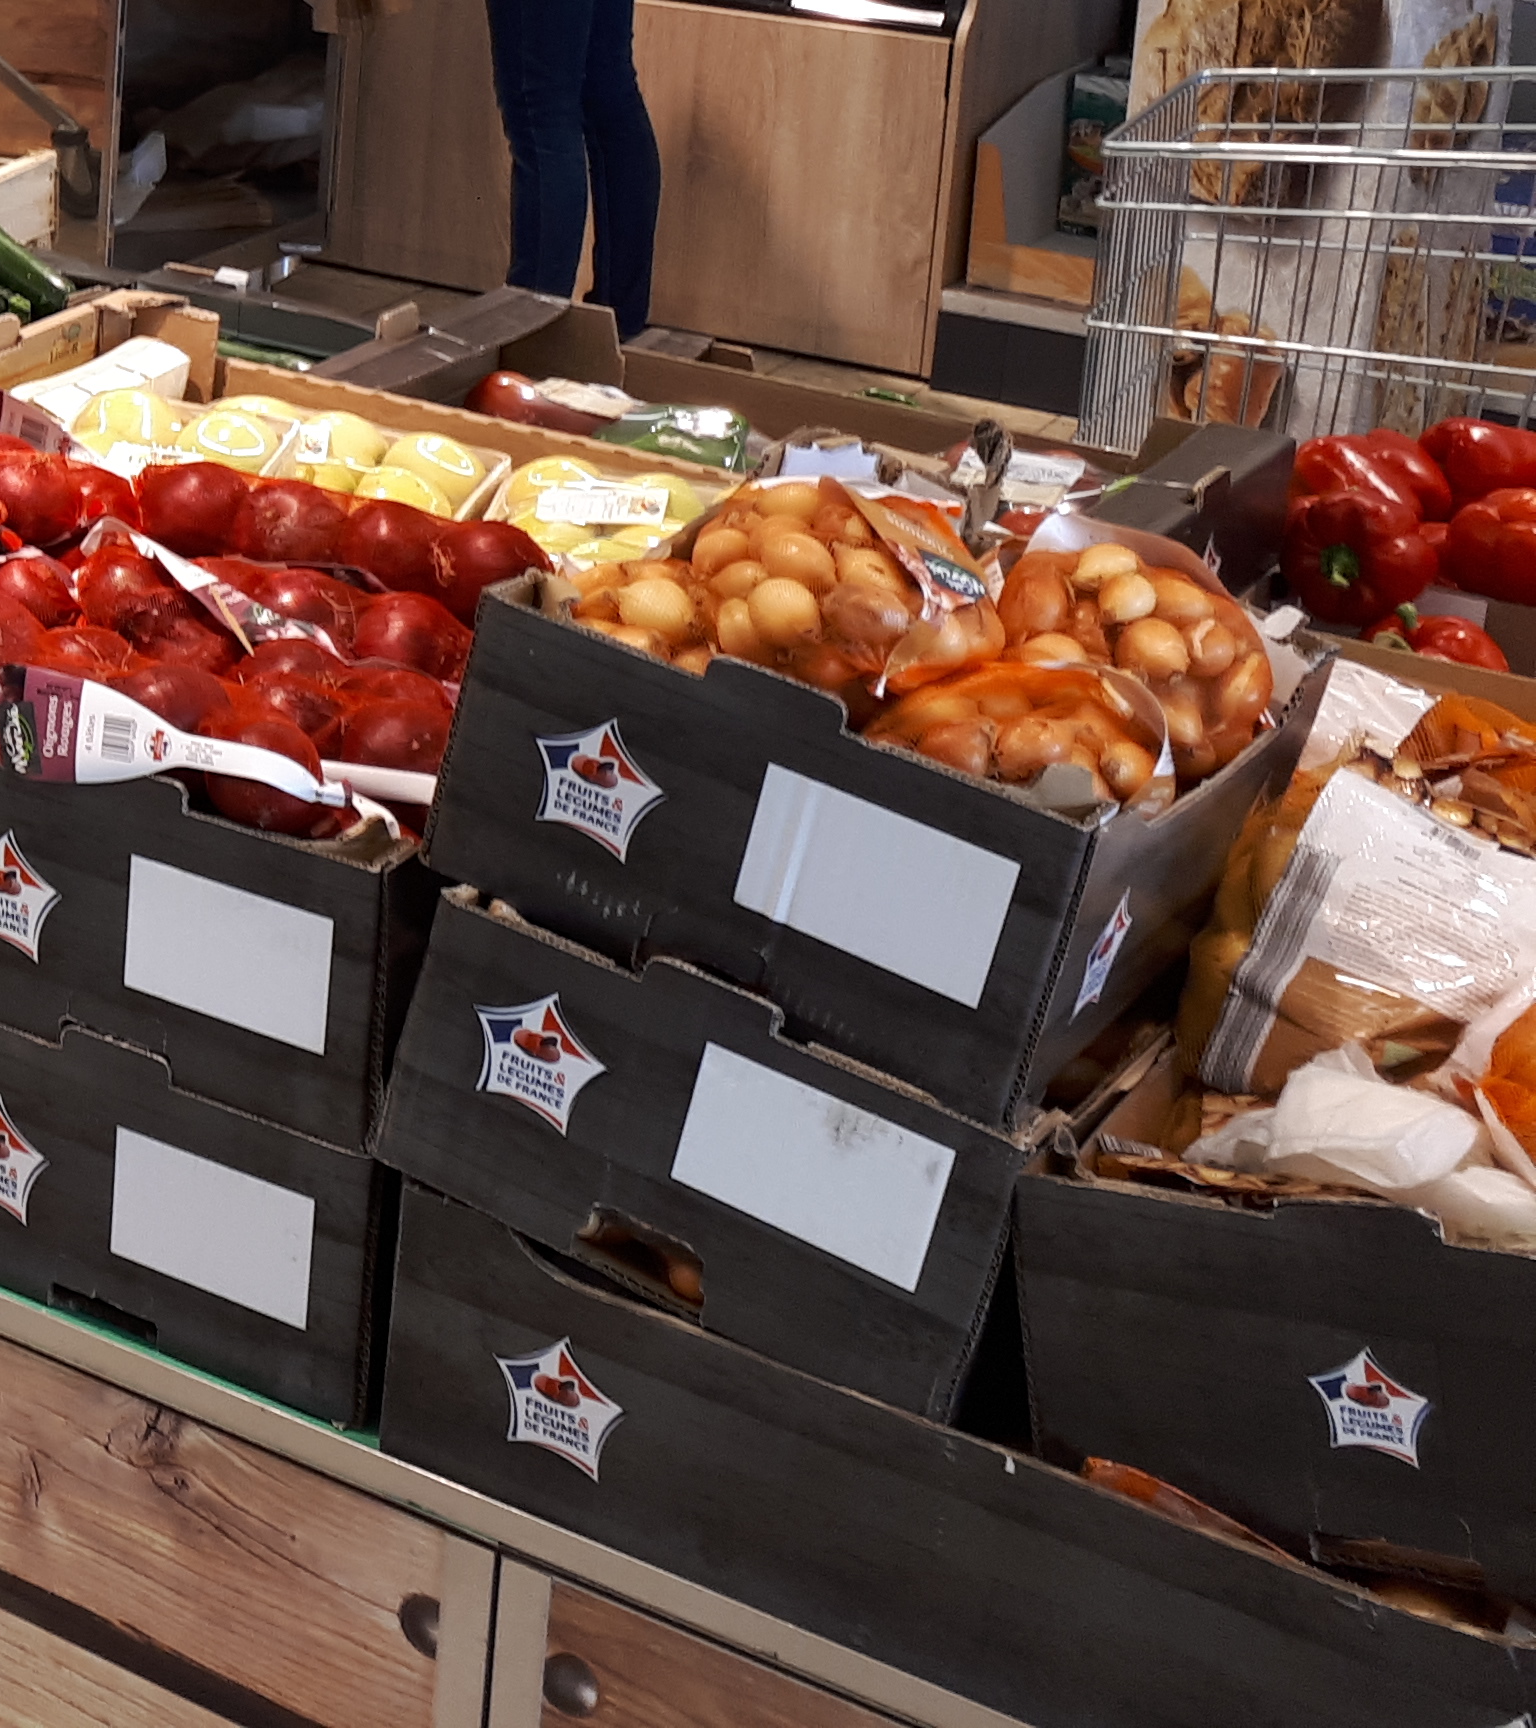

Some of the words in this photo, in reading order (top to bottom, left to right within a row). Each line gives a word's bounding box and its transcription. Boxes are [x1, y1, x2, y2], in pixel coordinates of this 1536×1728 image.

[42, 695, 59, 758] Oignons
[58, 701, 73, 757] Rouges
[559, 777, 610, 804] FRUITS
[554, 800, 570, 812] DE
[573, 809, 619, 835] FRANCE
[502, 1052, 553, 1080] FRUITS
[497, 1074, 512, 1086] DE
[515, 1083, 562, 1109] FRANCE
[526, 1396, 577, 1424] FRUITS
[524, 1419, 539, 1432] DE
[543, 1429, 589, 1454] FRANCE
